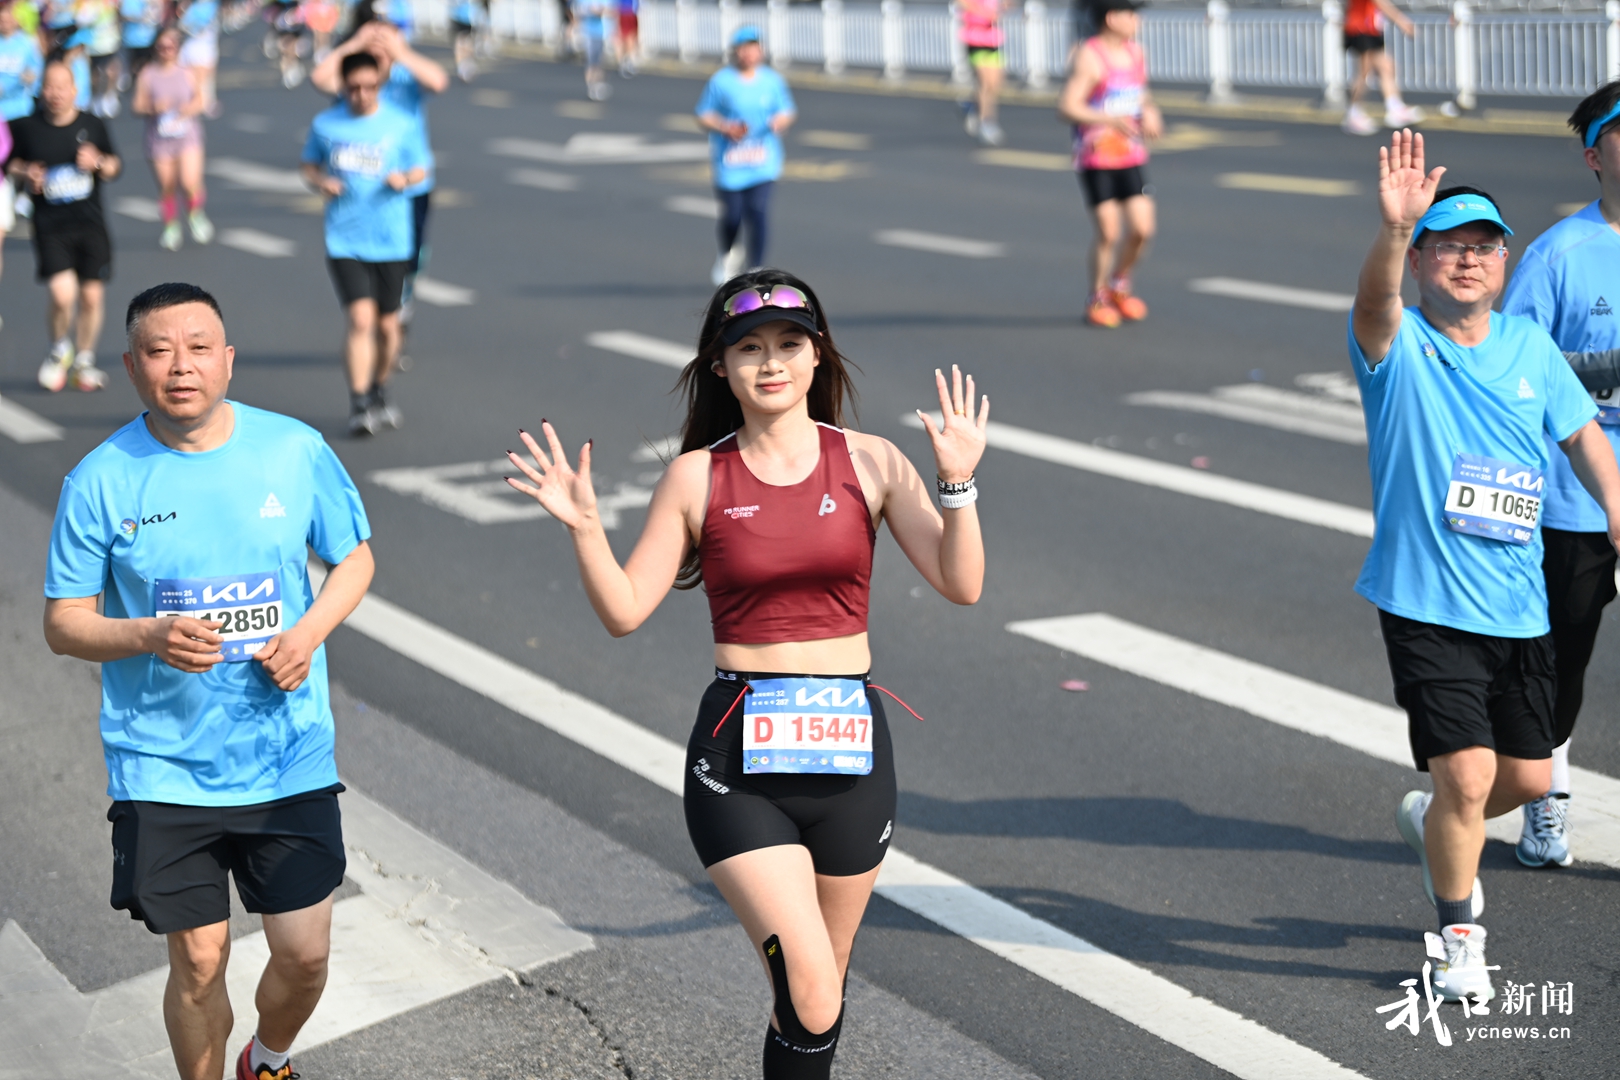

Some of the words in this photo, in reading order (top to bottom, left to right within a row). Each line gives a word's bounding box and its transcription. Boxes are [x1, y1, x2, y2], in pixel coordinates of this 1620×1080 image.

[1590, 307, 1613, 316] PEAK
[1496, 467, 1544, 492] KIA
[724, 507, 733, 515] PB
[732, 505, 760, 513] RUNNER
[1457, 485, 1475, 508] D
[1490, 492, 1540, 522] 10655
[141, 511, 177, 525] KIA
[731, 511, 753, 519] CITIES
[183, 589, 193, 597] 25
[202, 578, 274, 604] KIA
[184, 597, 197, 605] 370
[775, 698, 789, 706] 287
[795, 686, 866, 707] KIA
[753, 716, 774, 743] D
[791, 716, 869, 743] 15447
[697, 757, 710, 771] PB
[692, 765, 730, 795] RUNNER
